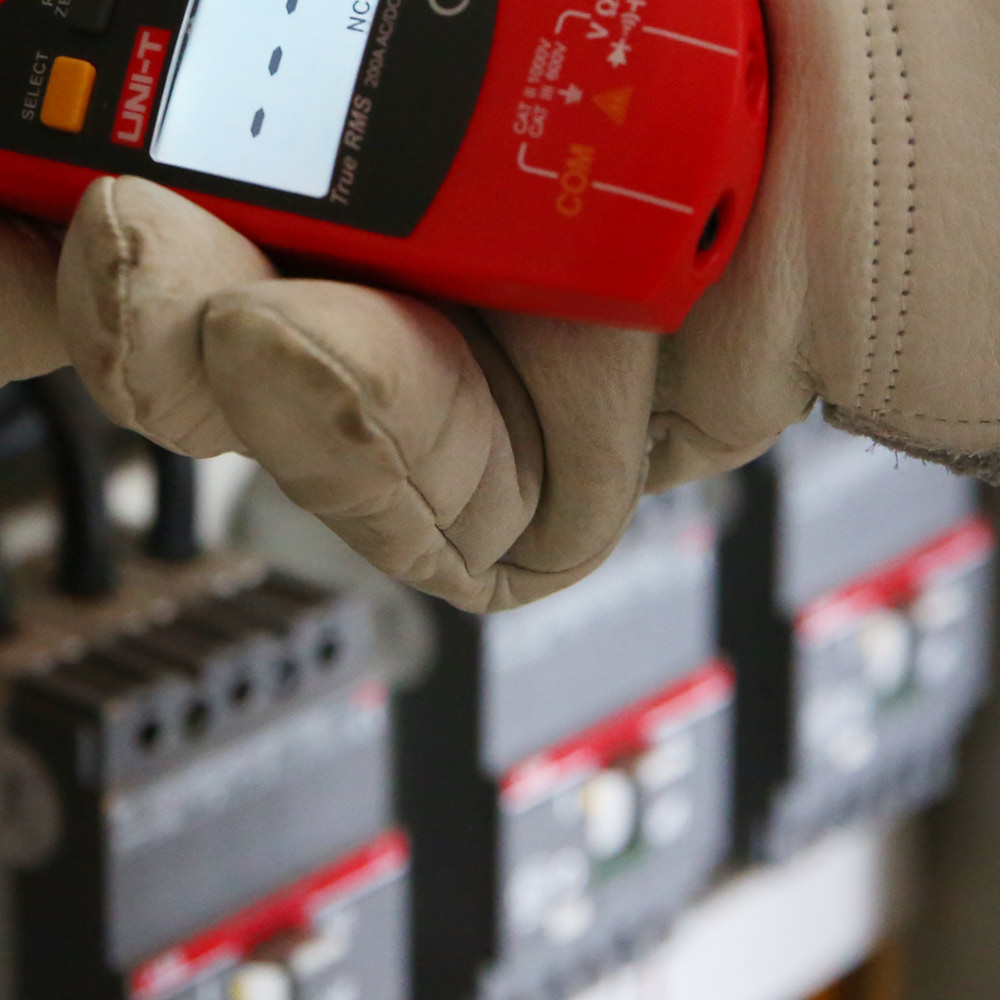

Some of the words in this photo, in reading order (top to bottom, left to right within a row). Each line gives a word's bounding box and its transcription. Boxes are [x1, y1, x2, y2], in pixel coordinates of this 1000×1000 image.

[20, 51, 49, 121] SELECT
[116, 30, 163, 143] UNI-T
[343, 93, 373, 152] RMS
[330, 154, 358, 206] True
[555, 142, 596, 217] COM
